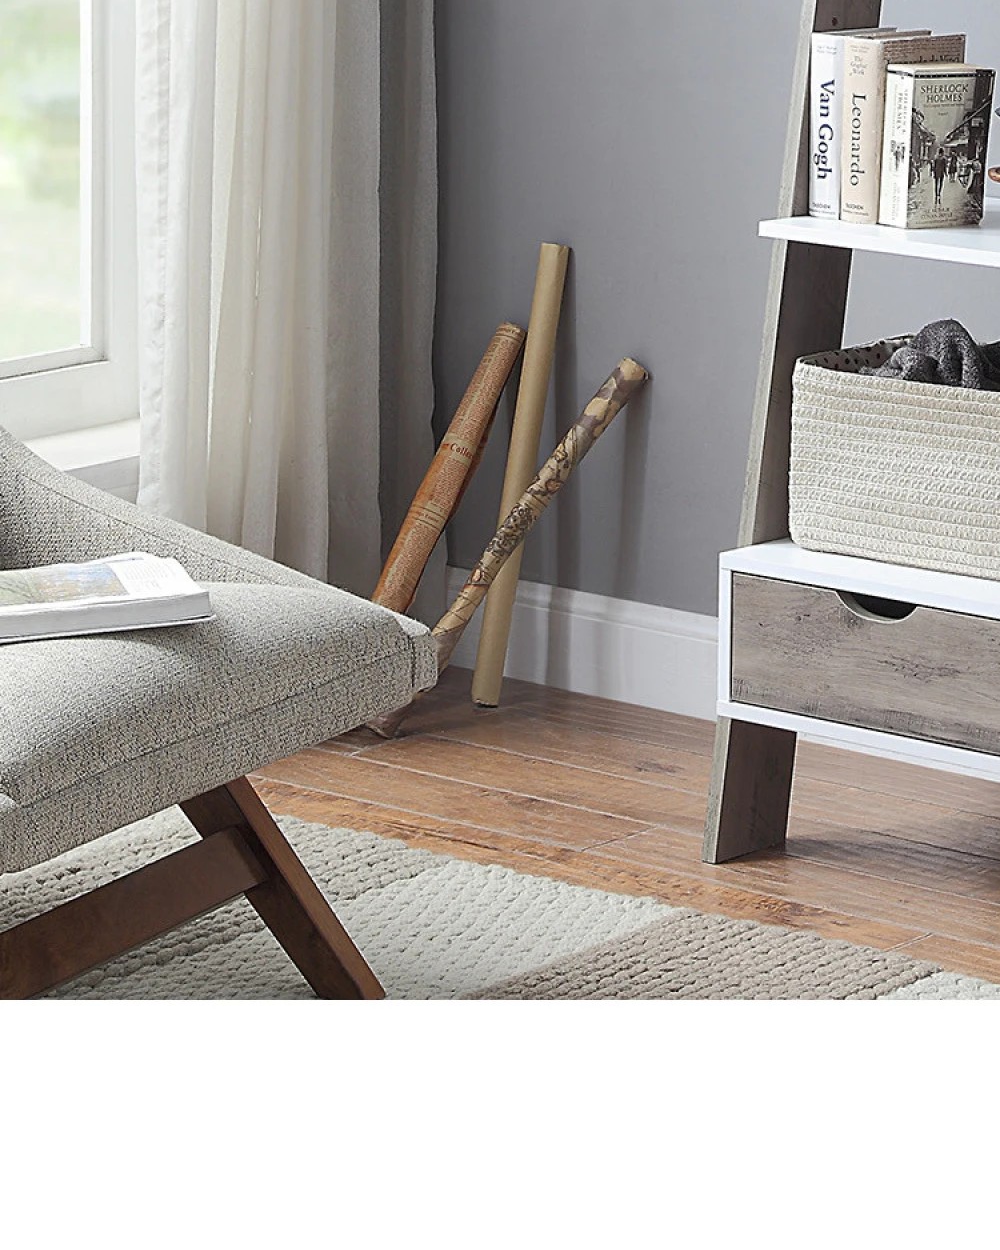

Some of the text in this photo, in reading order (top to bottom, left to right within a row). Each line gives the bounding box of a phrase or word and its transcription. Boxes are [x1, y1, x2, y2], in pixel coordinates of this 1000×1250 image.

[920, 83, 969, 94] SHERLOCK
[926, 93, 962, 103] HOLMES
[813, 80, 835, 180] Van Gogh
[849, 92, 867, 187] Leonardo
